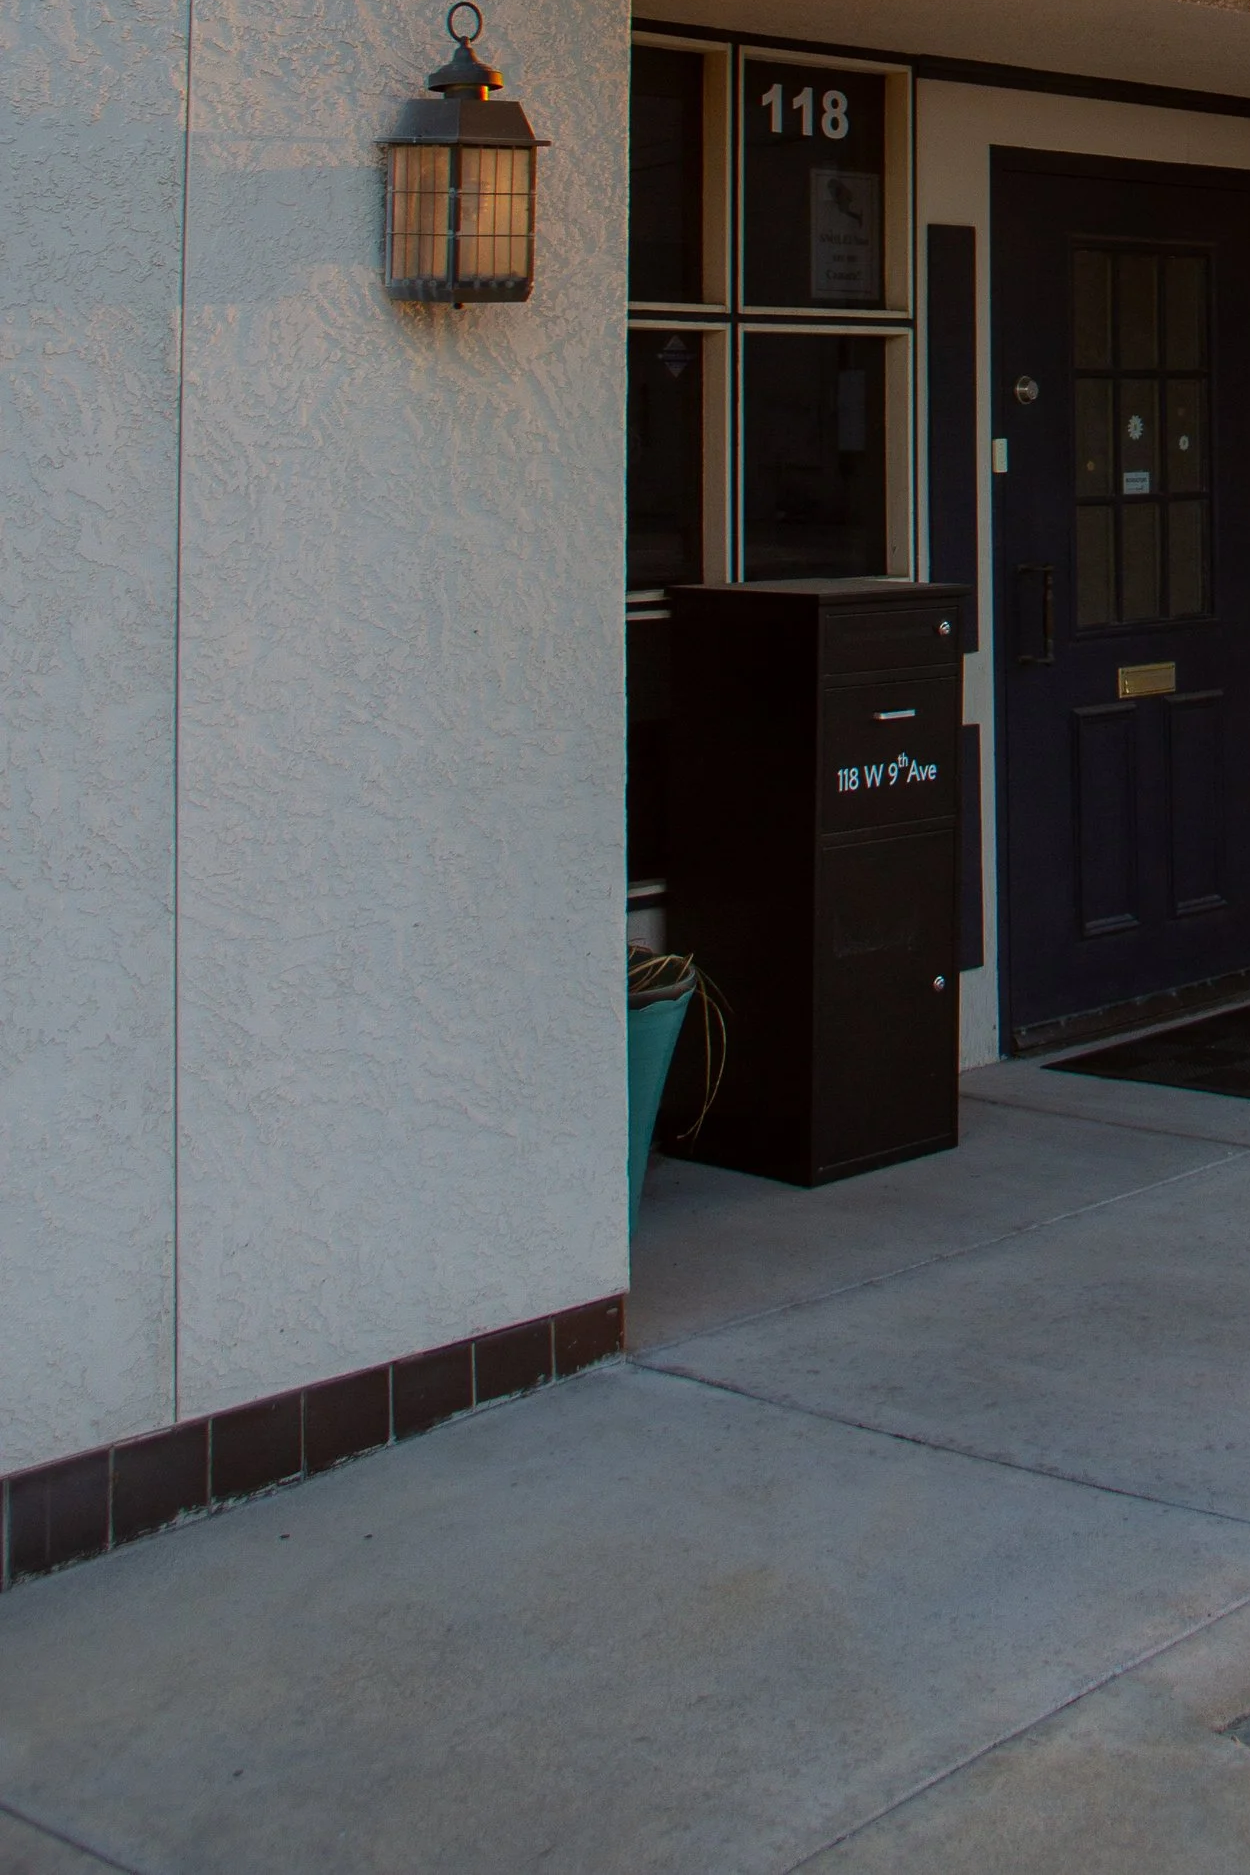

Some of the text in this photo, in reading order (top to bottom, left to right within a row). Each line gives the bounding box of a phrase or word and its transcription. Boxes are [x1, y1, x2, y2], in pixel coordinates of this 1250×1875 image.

[762, 83, 849, 139] 118
[837, 752, 937, 793] 118 W 9th Ave
